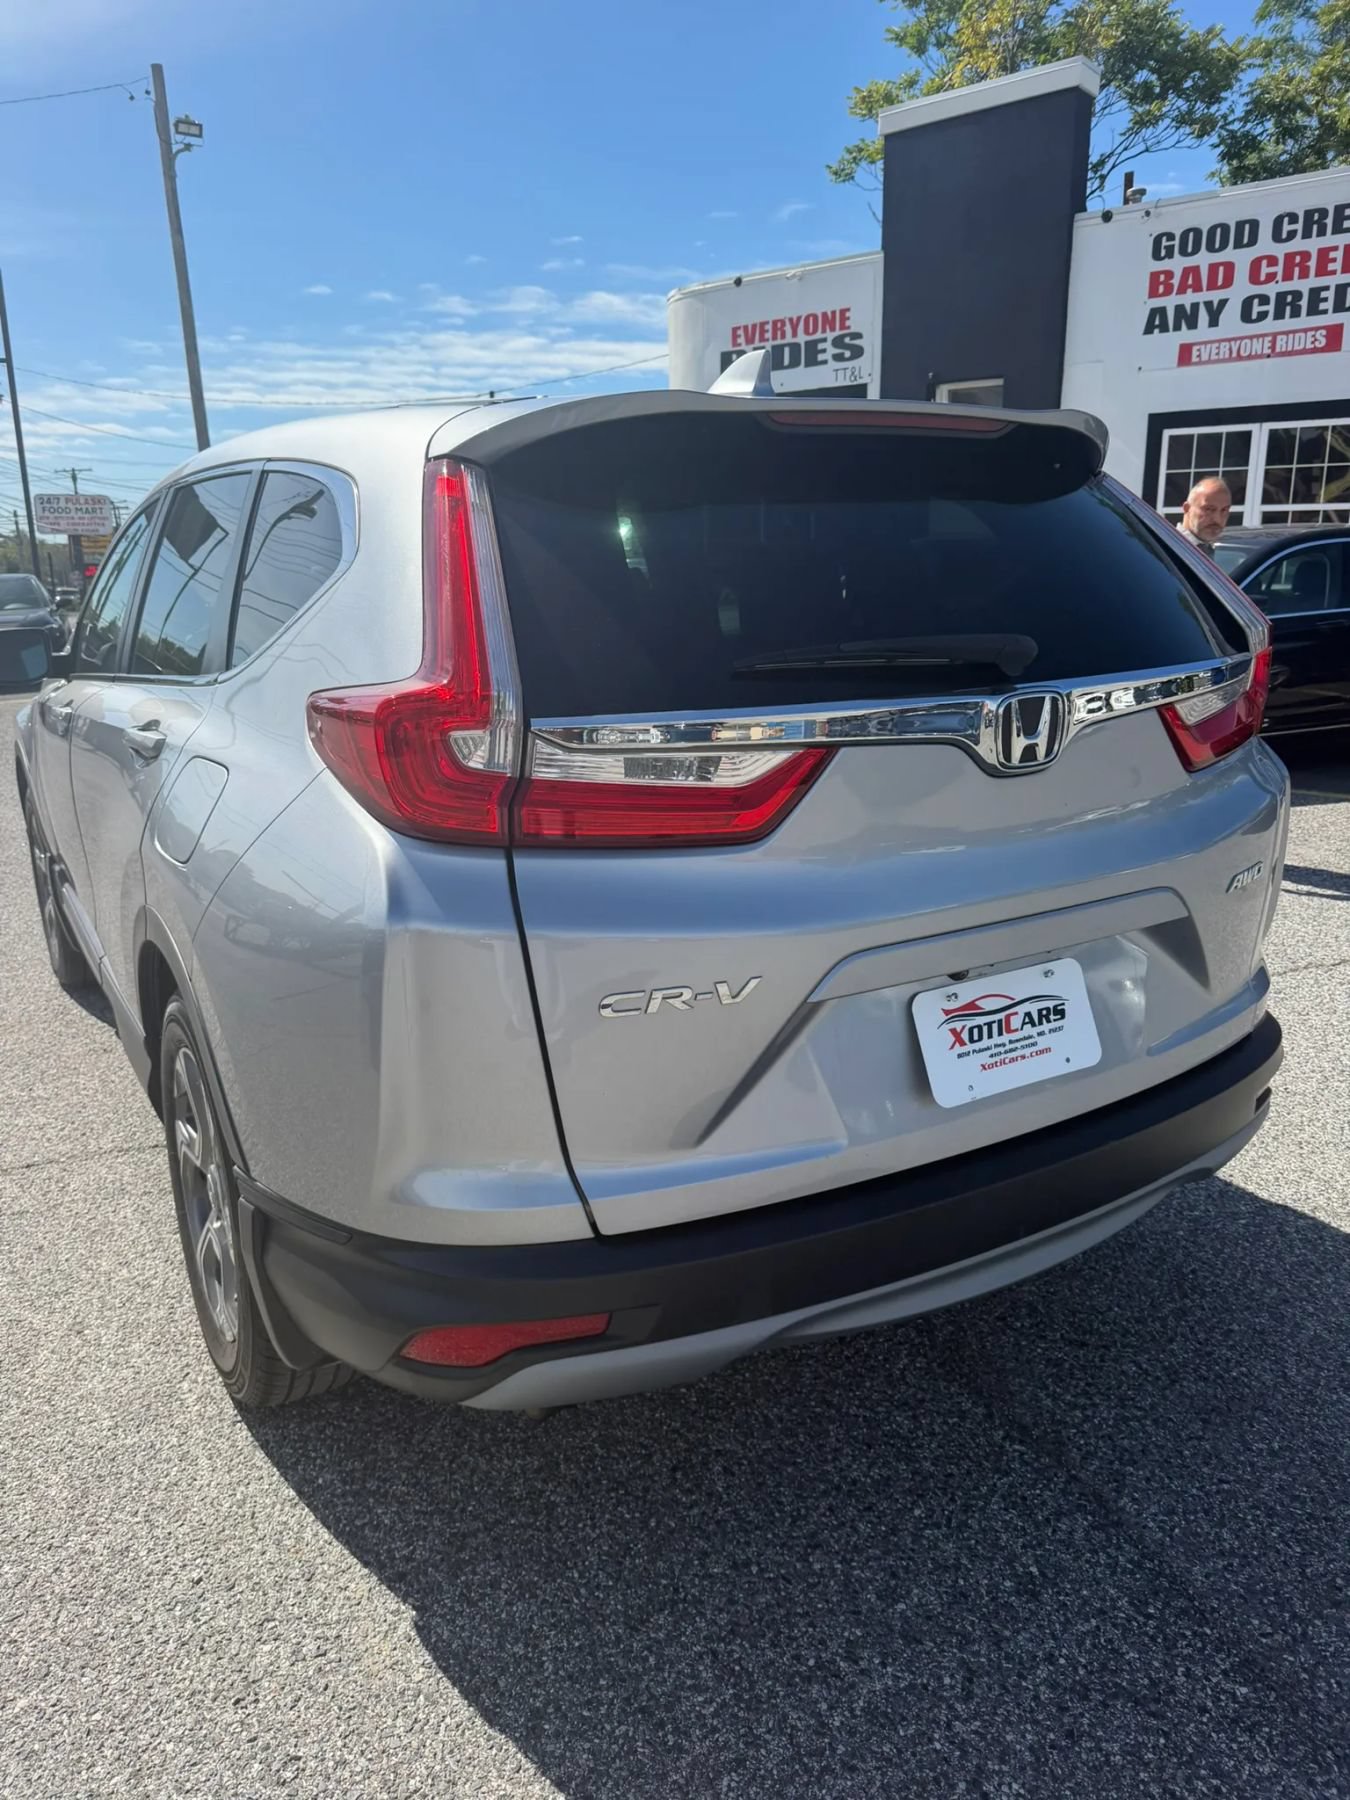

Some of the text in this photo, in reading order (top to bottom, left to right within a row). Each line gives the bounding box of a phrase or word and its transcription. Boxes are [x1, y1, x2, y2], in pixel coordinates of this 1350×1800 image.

[1151, 218, 1260, 261] GOOD
[1148, 261, 1235, 299] BAD
[731, 307, 852, 348] EVERYONE
[1143, 298, 1230, 335] ANY
[1191, 329, 1327, 363] EVERYONE RIDES
[833, 366, 864, 382] TT&L
[39, 497, 106, 505] 24/7 PULASKI
[42, 506, 104, 515] FOOD MART
[1225, 860, 1263, 893] AWD
[599, 976, 762, 1018] CR-V
[980, 1047, 1052, 1072] XotiCars.com
